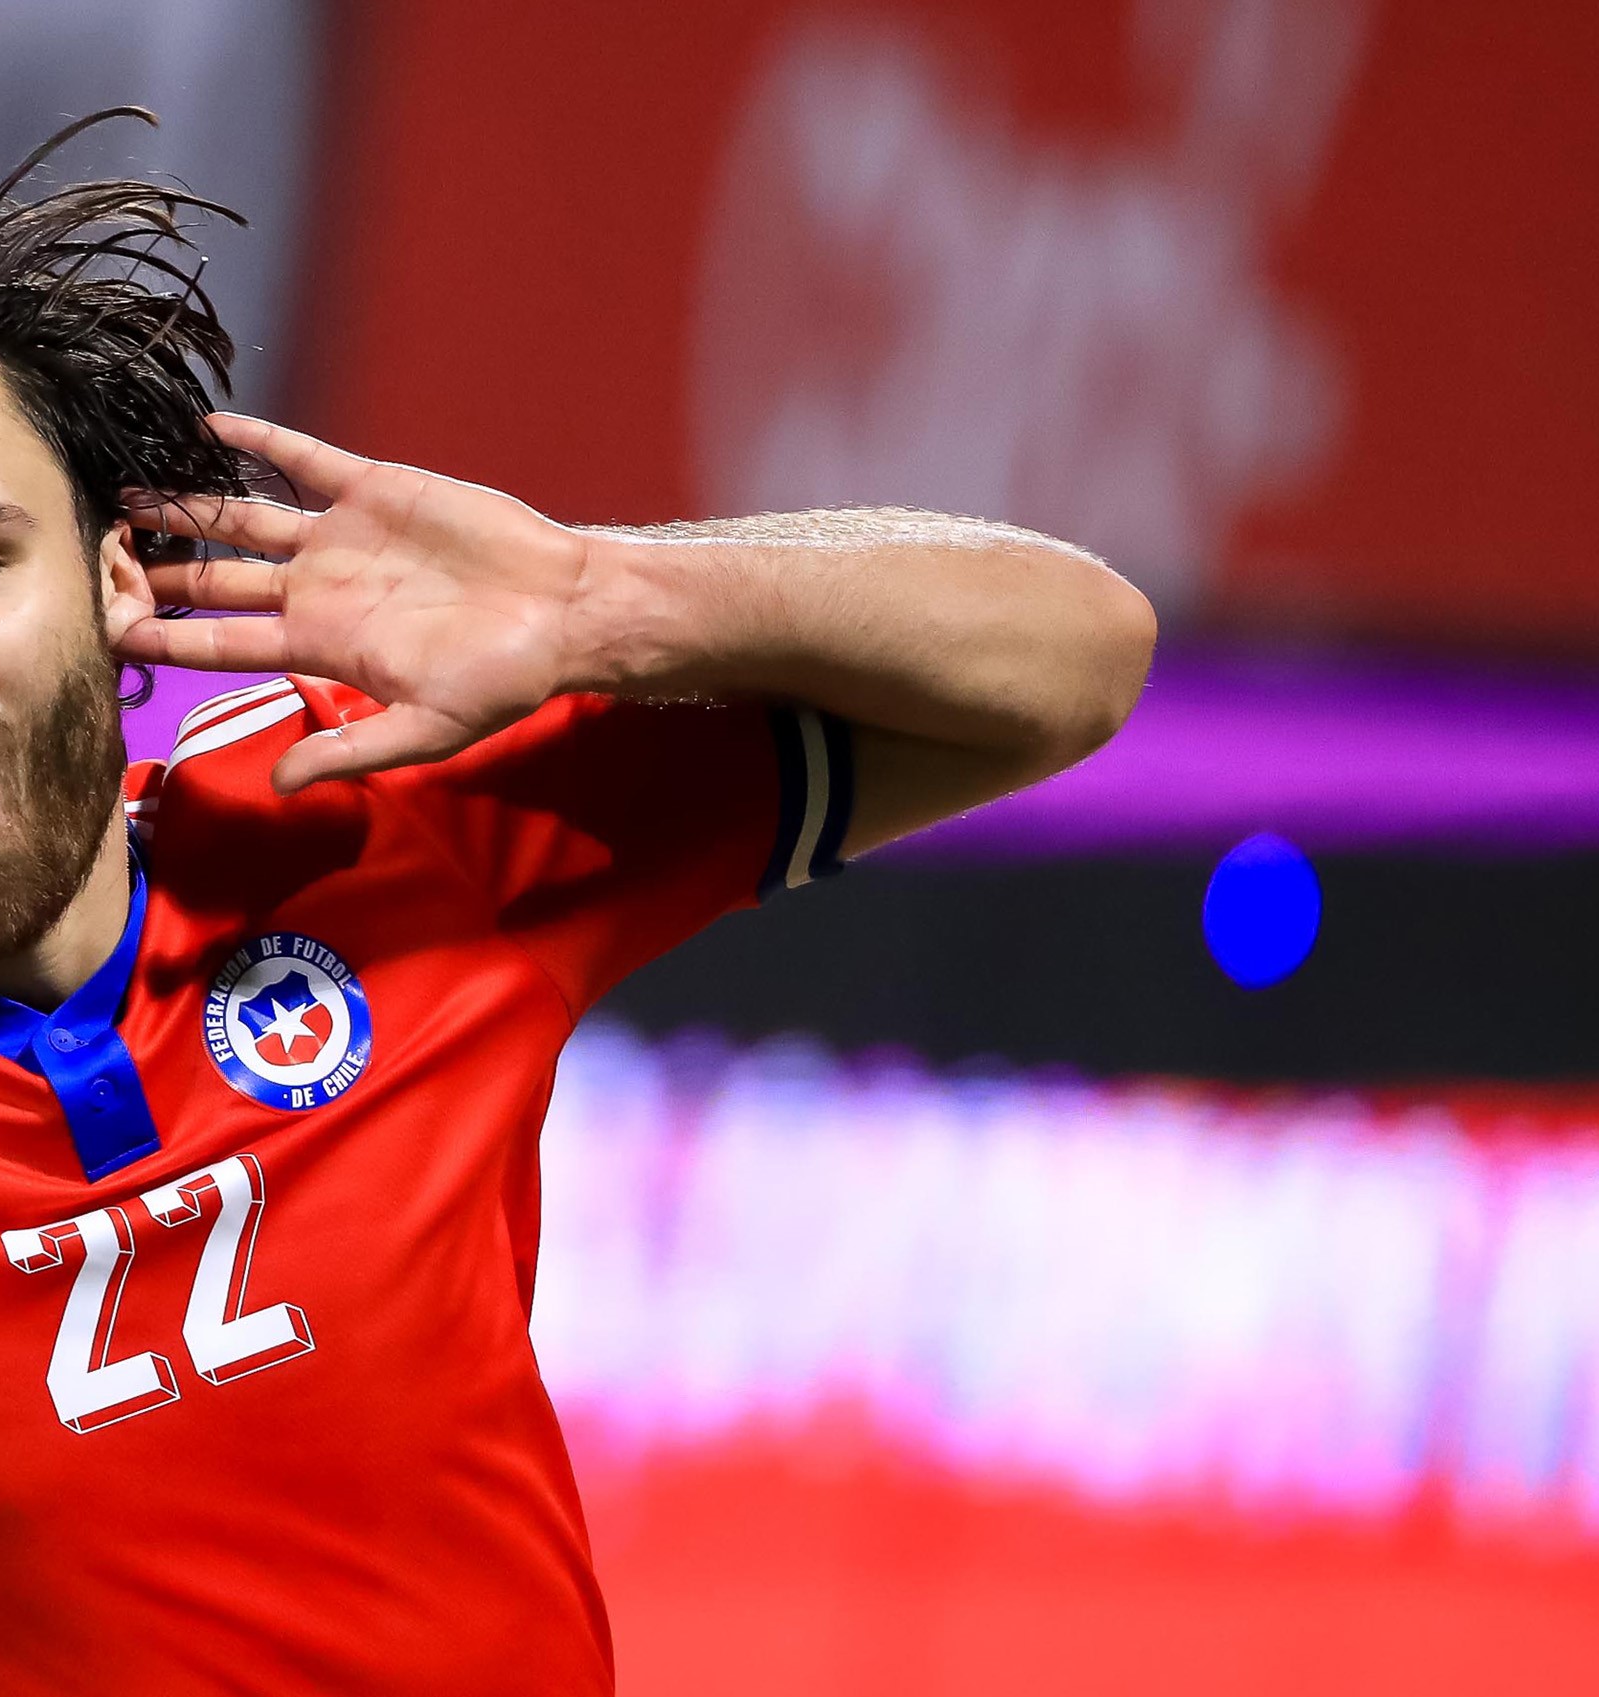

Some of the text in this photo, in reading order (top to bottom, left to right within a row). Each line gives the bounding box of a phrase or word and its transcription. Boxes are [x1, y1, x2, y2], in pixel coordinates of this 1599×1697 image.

[260, 936, 282, 956] DE
[293, 937, 351, 989] FUTBOL
[0, 1153, 315, 1434] 22
